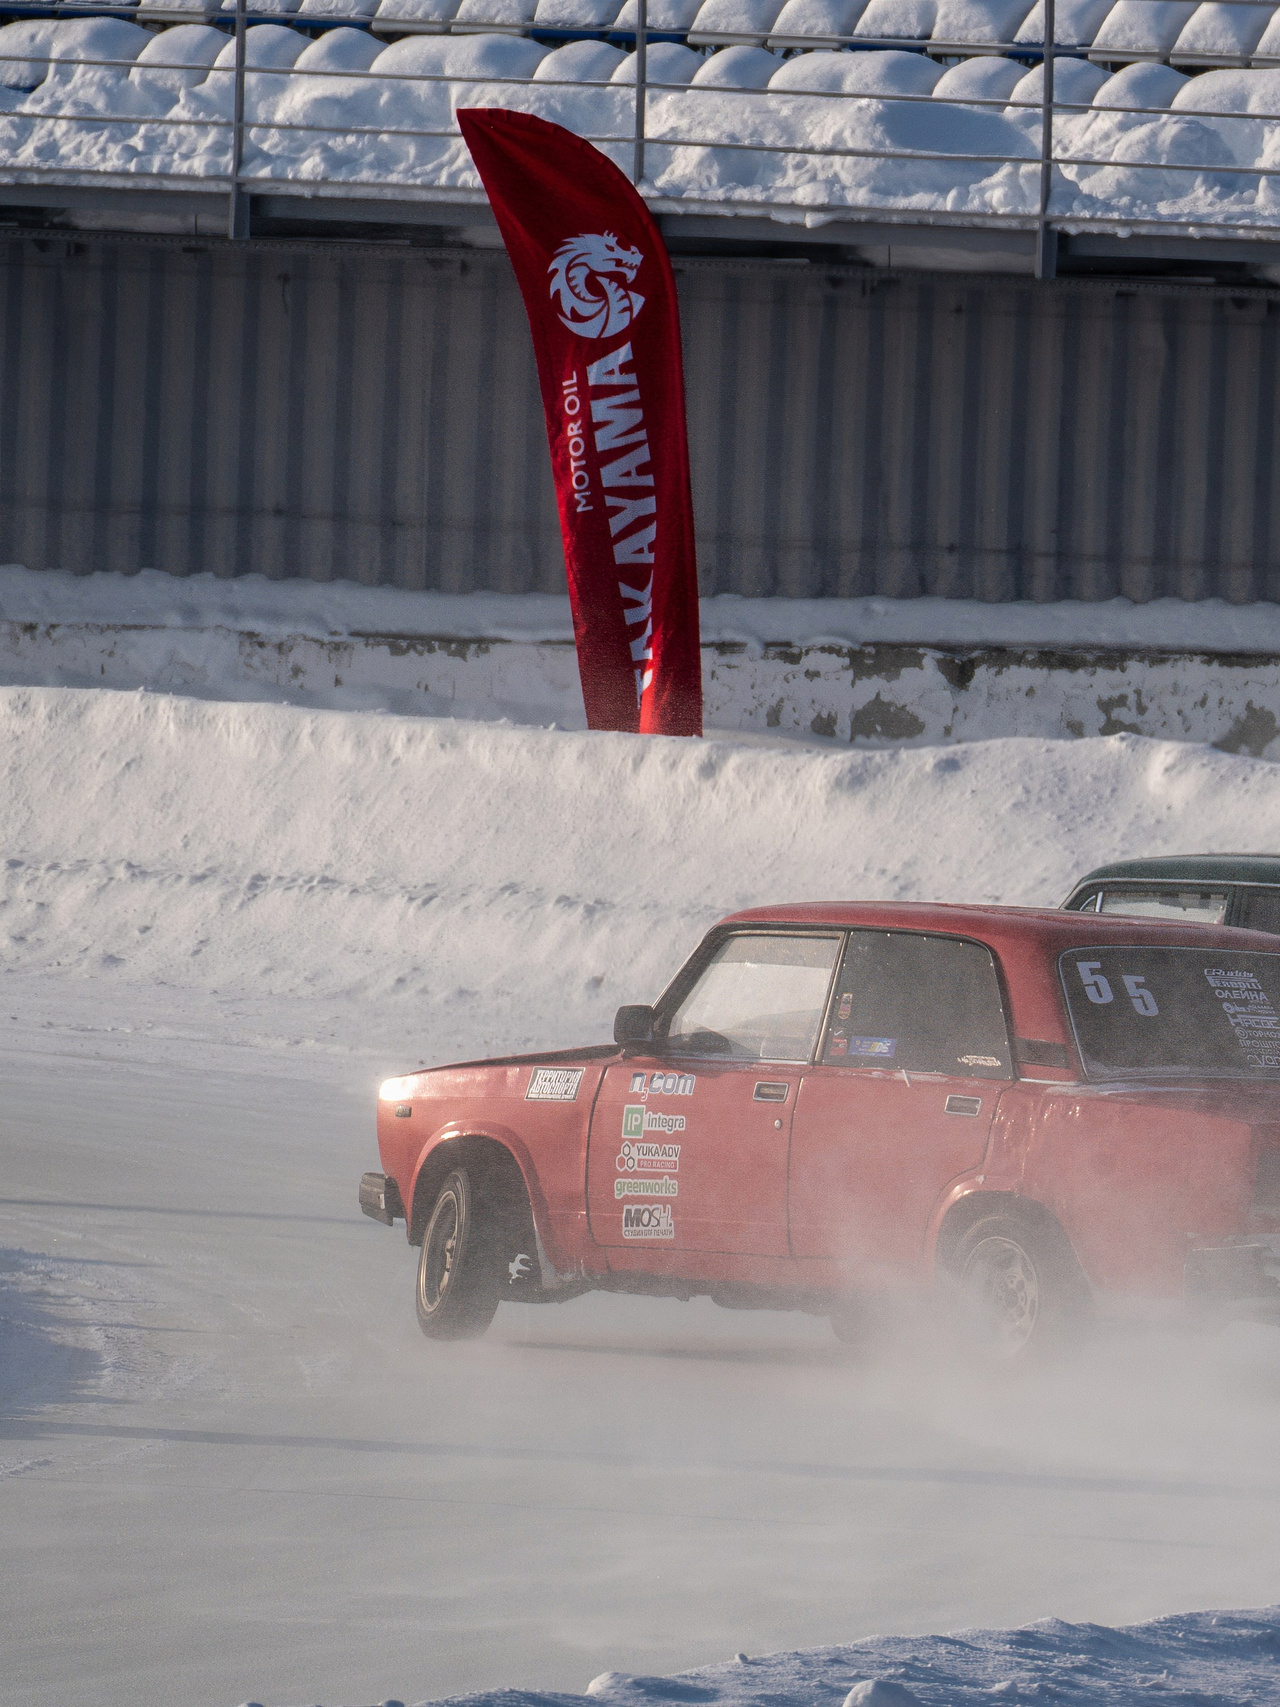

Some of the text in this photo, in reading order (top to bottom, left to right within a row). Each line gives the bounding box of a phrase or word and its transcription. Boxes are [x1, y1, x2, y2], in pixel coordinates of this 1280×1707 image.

[562, 370, 593, 512] MOTOR OIL
[1215, 988, 1268, 1001] ОЛЕЙНА
[534, 1069, 583, 1083] ТЕРРИТОРИЯ
[529, 1081, 577, 1095] АВТОСПОРТА
[627, 1113, 642, 1131] IP
[636, 1145, 680, 1158] YUKA ADV
[639, 1160, 675, 1169] PRO RACING
[615, 1178, 677, 1198] greenworks
